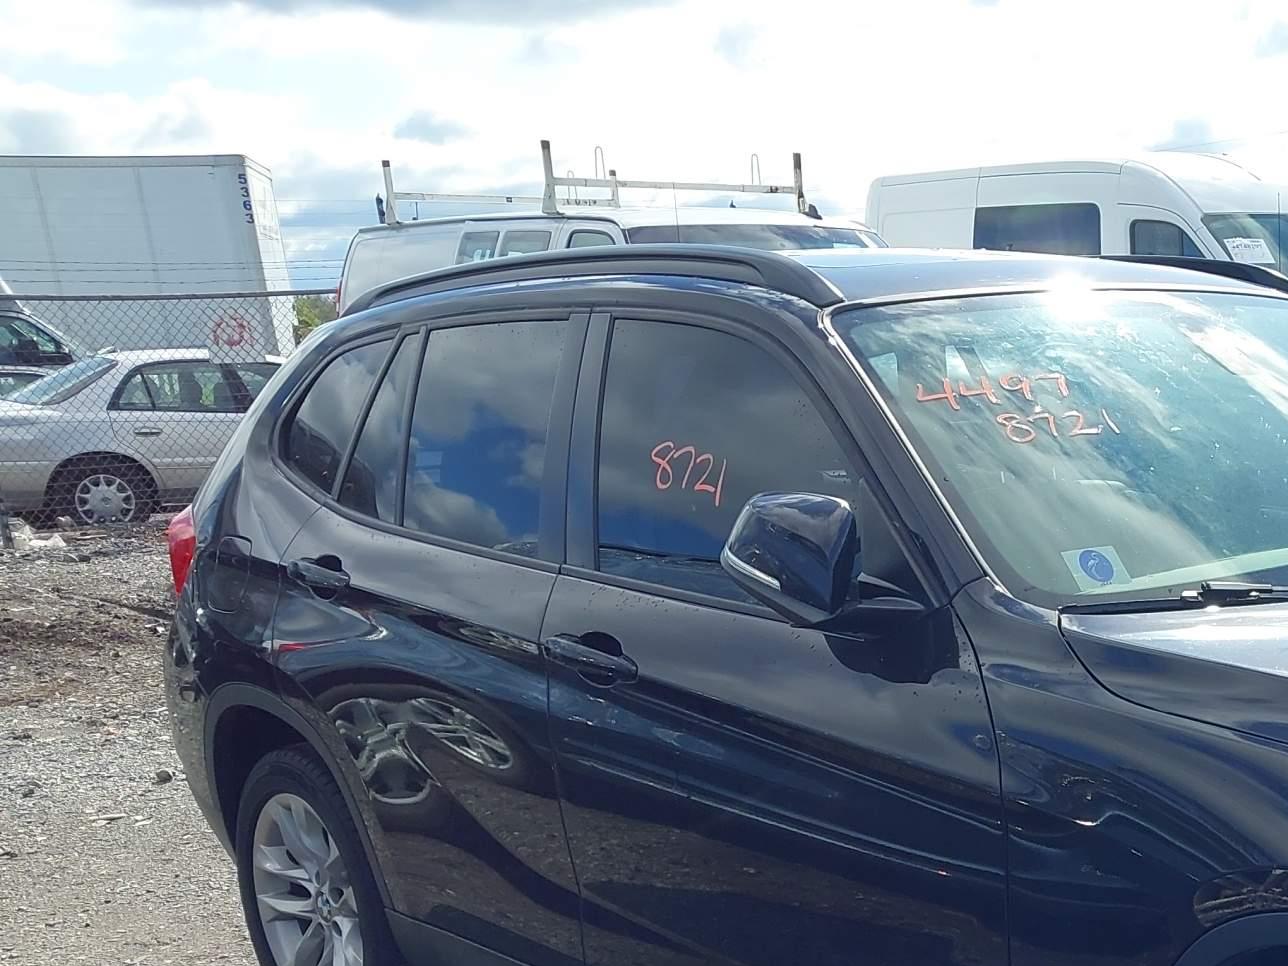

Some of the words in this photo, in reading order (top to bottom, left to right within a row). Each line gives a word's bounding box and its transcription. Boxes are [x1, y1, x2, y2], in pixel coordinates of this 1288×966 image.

[238, 173, 255, 224] 5363
[916, 372, 1070, 411] 4497
[996, 408, 1121, 443] 8721
[651, 441, 727, 507] 8721
